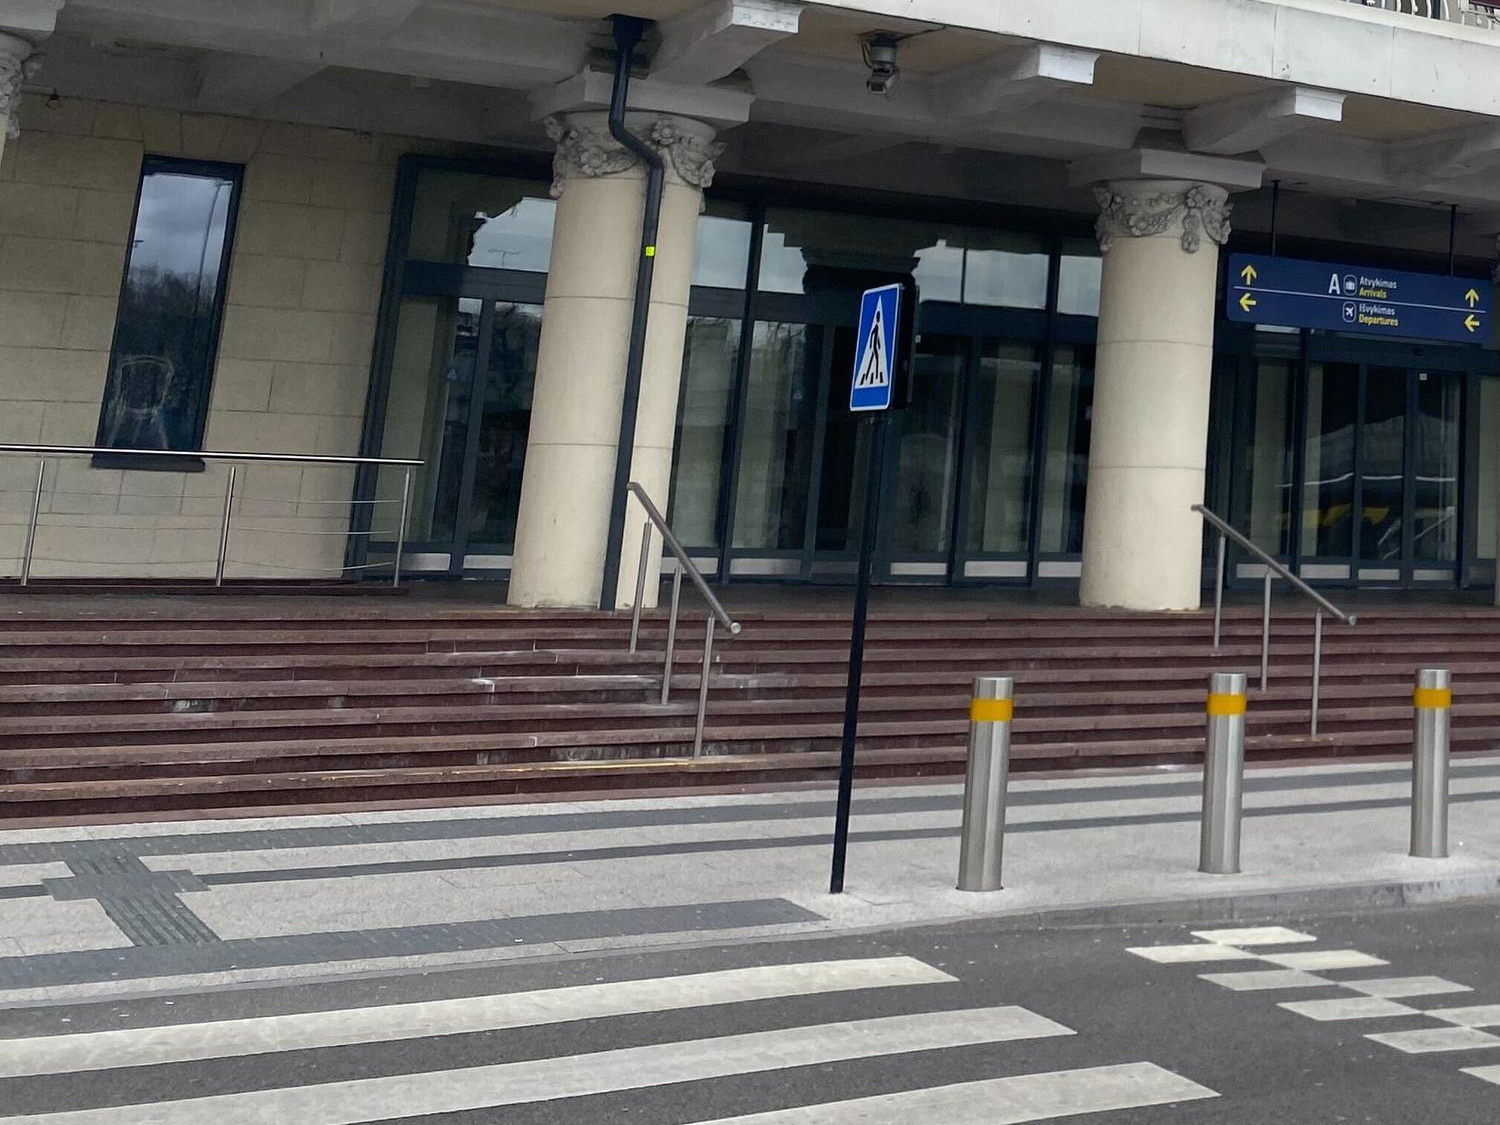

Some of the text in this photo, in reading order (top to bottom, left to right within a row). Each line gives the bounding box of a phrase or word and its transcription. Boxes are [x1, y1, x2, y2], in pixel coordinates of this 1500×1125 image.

[1328, 273, 1397, 295] A Atvykimas
[1359, 287, 1387, 299] Arrivals
[1359, 303, 1395, 316] Išvykimas
[1358, 314, 1399, 326] Departures
